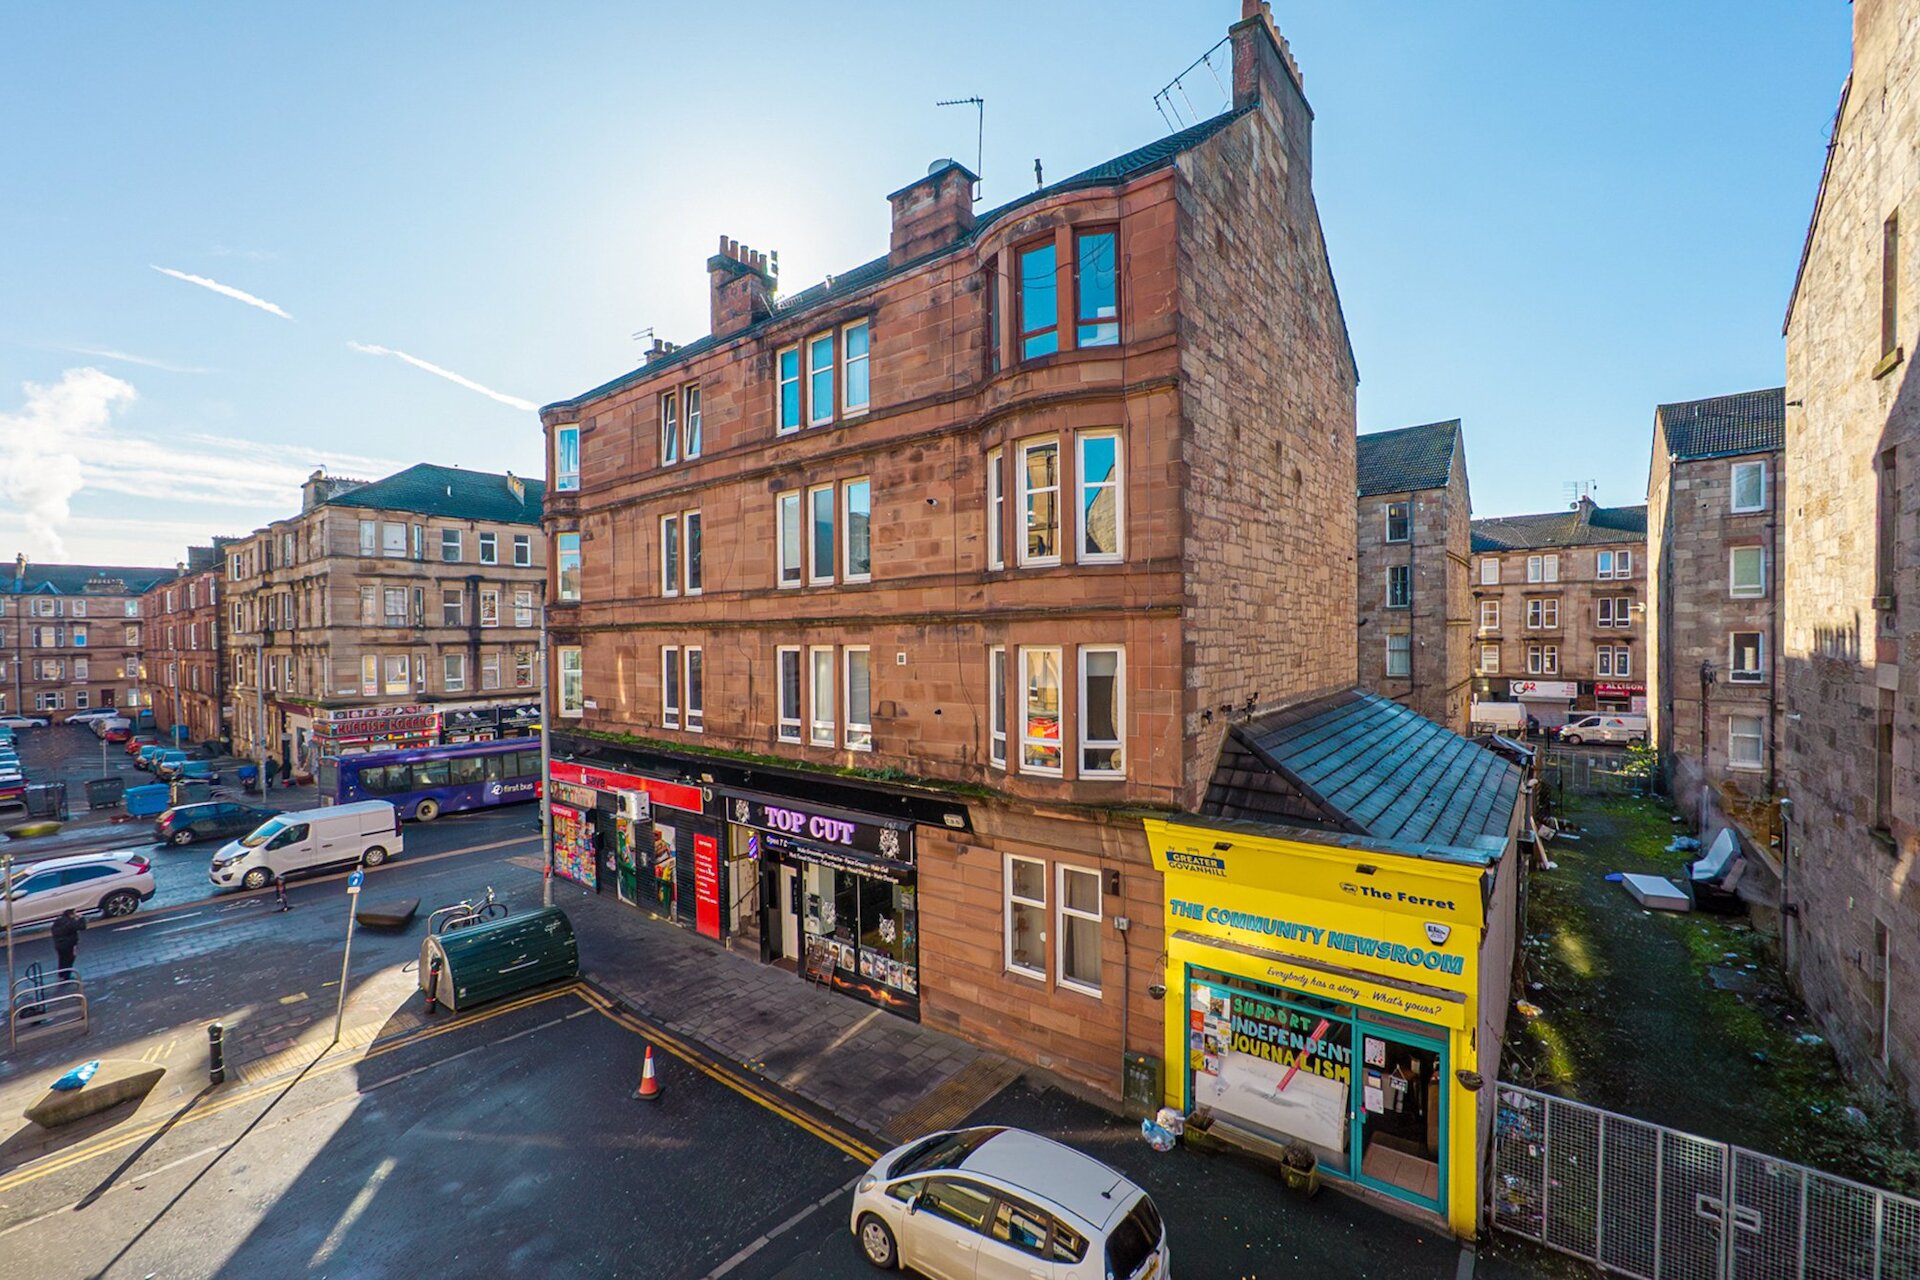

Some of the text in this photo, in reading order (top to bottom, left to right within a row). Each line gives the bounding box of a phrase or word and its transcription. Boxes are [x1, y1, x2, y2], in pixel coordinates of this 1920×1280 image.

[504, 783, 533, 792] first bus
[765, 806, 855, 845] TOP CUT
[1168, 861, 1227, 877] GOVANHILL
[1172, 853, 1218, 868] GREATER
[1360, 886, 1456, 911] The Ferret
[1170, 899, 1465, 975] THE COMMUNITY NEWSROOM
[1267, 966, 1309, 987] Everybody
[1310, 977, 1327, 989] has
[1372, 991, 1403, 1007] What's
[1404, 1001, 1442, 1016] yours?
[1233, 998, 1311, 1031] SUPPORT
[1231, 1015, 1352, 1064] INDEPENDENT
[1229, 1033, 1350, 1085] JOURNALISM
